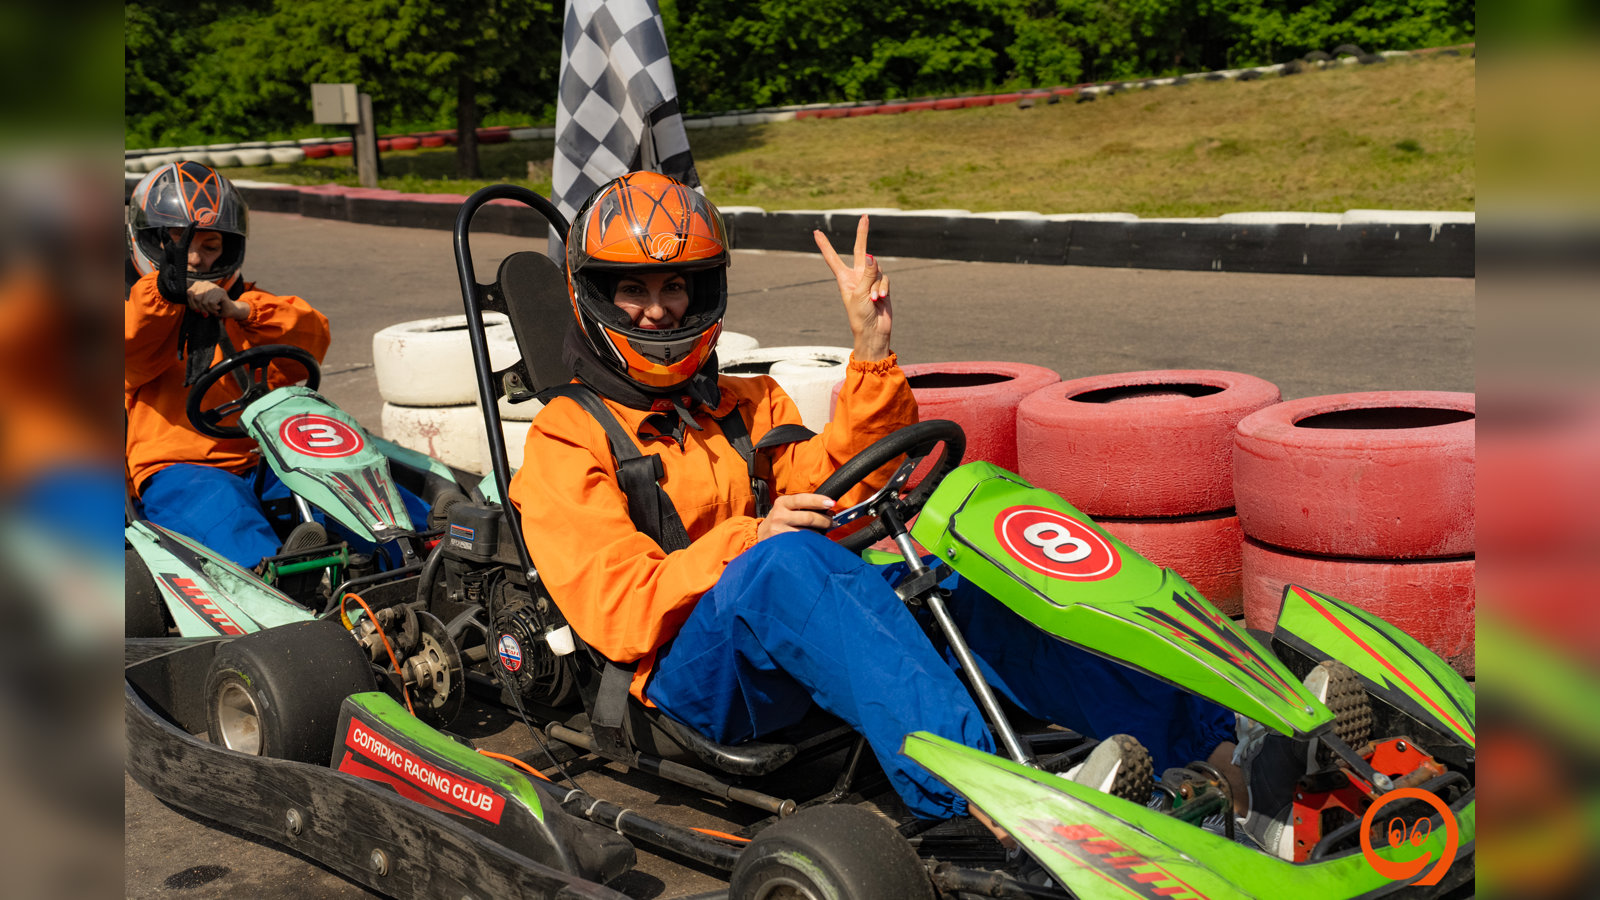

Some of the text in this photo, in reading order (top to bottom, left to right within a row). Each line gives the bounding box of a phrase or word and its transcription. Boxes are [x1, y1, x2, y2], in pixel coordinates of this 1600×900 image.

[297, 424, 344, 447] 3
[1023, 522, 1092, 564] 8
[353, 728, 493, 811] СОЛЯРИС RACING CLUB
